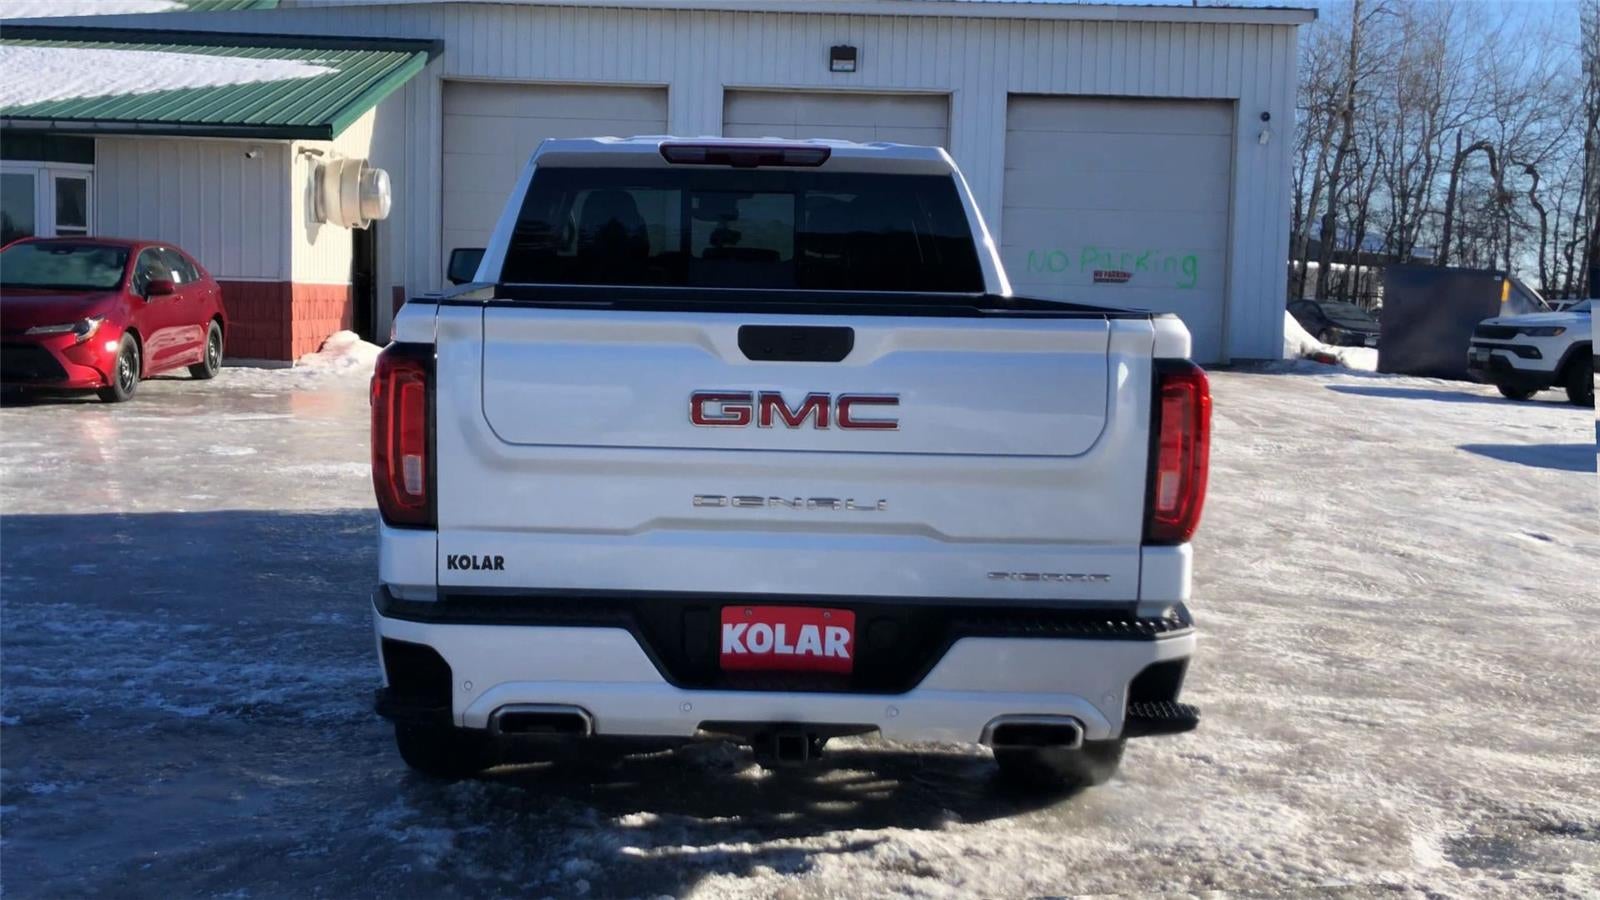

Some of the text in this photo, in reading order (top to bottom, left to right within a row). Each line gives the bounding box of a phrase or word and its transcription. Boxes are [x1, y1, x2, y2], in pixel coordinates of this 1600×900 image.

[689, 390, 900, 431] GMC
[693, 495, 888, 511] DENALI
[447, 554, 505, 571] KOLAR
[987, 571, 1111, 582] SIERRA
[721, 622, 851, 659] KOLAR
